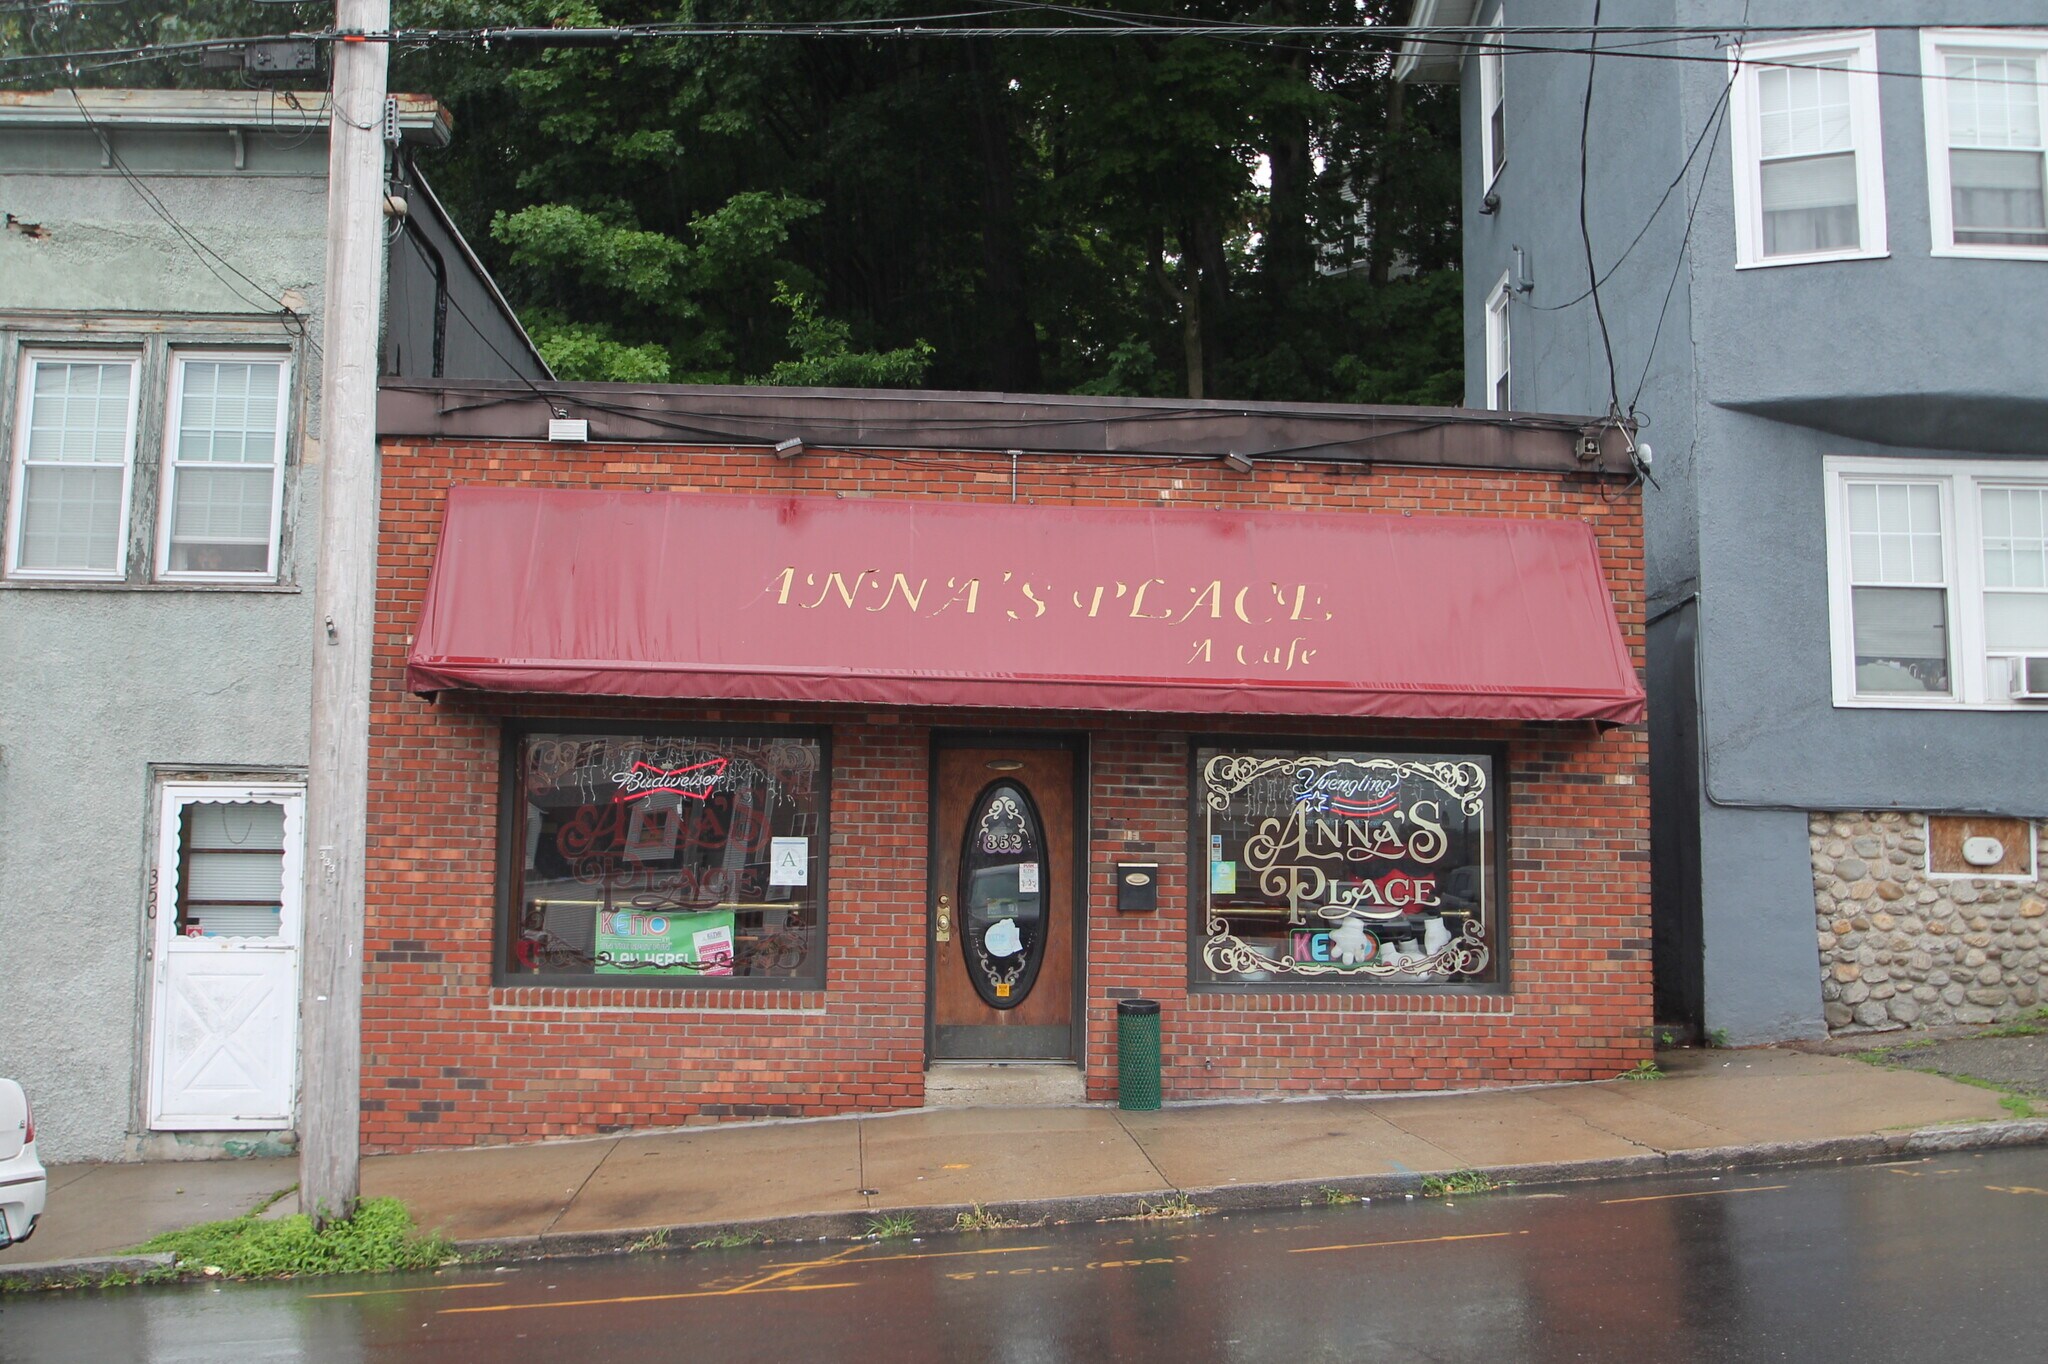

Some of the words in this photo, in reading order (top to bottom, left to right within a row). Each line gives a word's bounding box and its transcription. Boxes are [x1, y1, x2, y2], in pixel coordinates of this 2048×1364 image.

[757, 566, 1052, 622] ANNA'S
[1073, 578, 1333, 626] PLACE
[1187, 638, 1212, 665] A
[611, 771, 726, 792] Budweiser
[1292, 767, 1400, 799] Yuengling
[984, 833, 1023, 852] 352
[781, 851, 796, 867] A
[147, 868, 159, 920] 350
